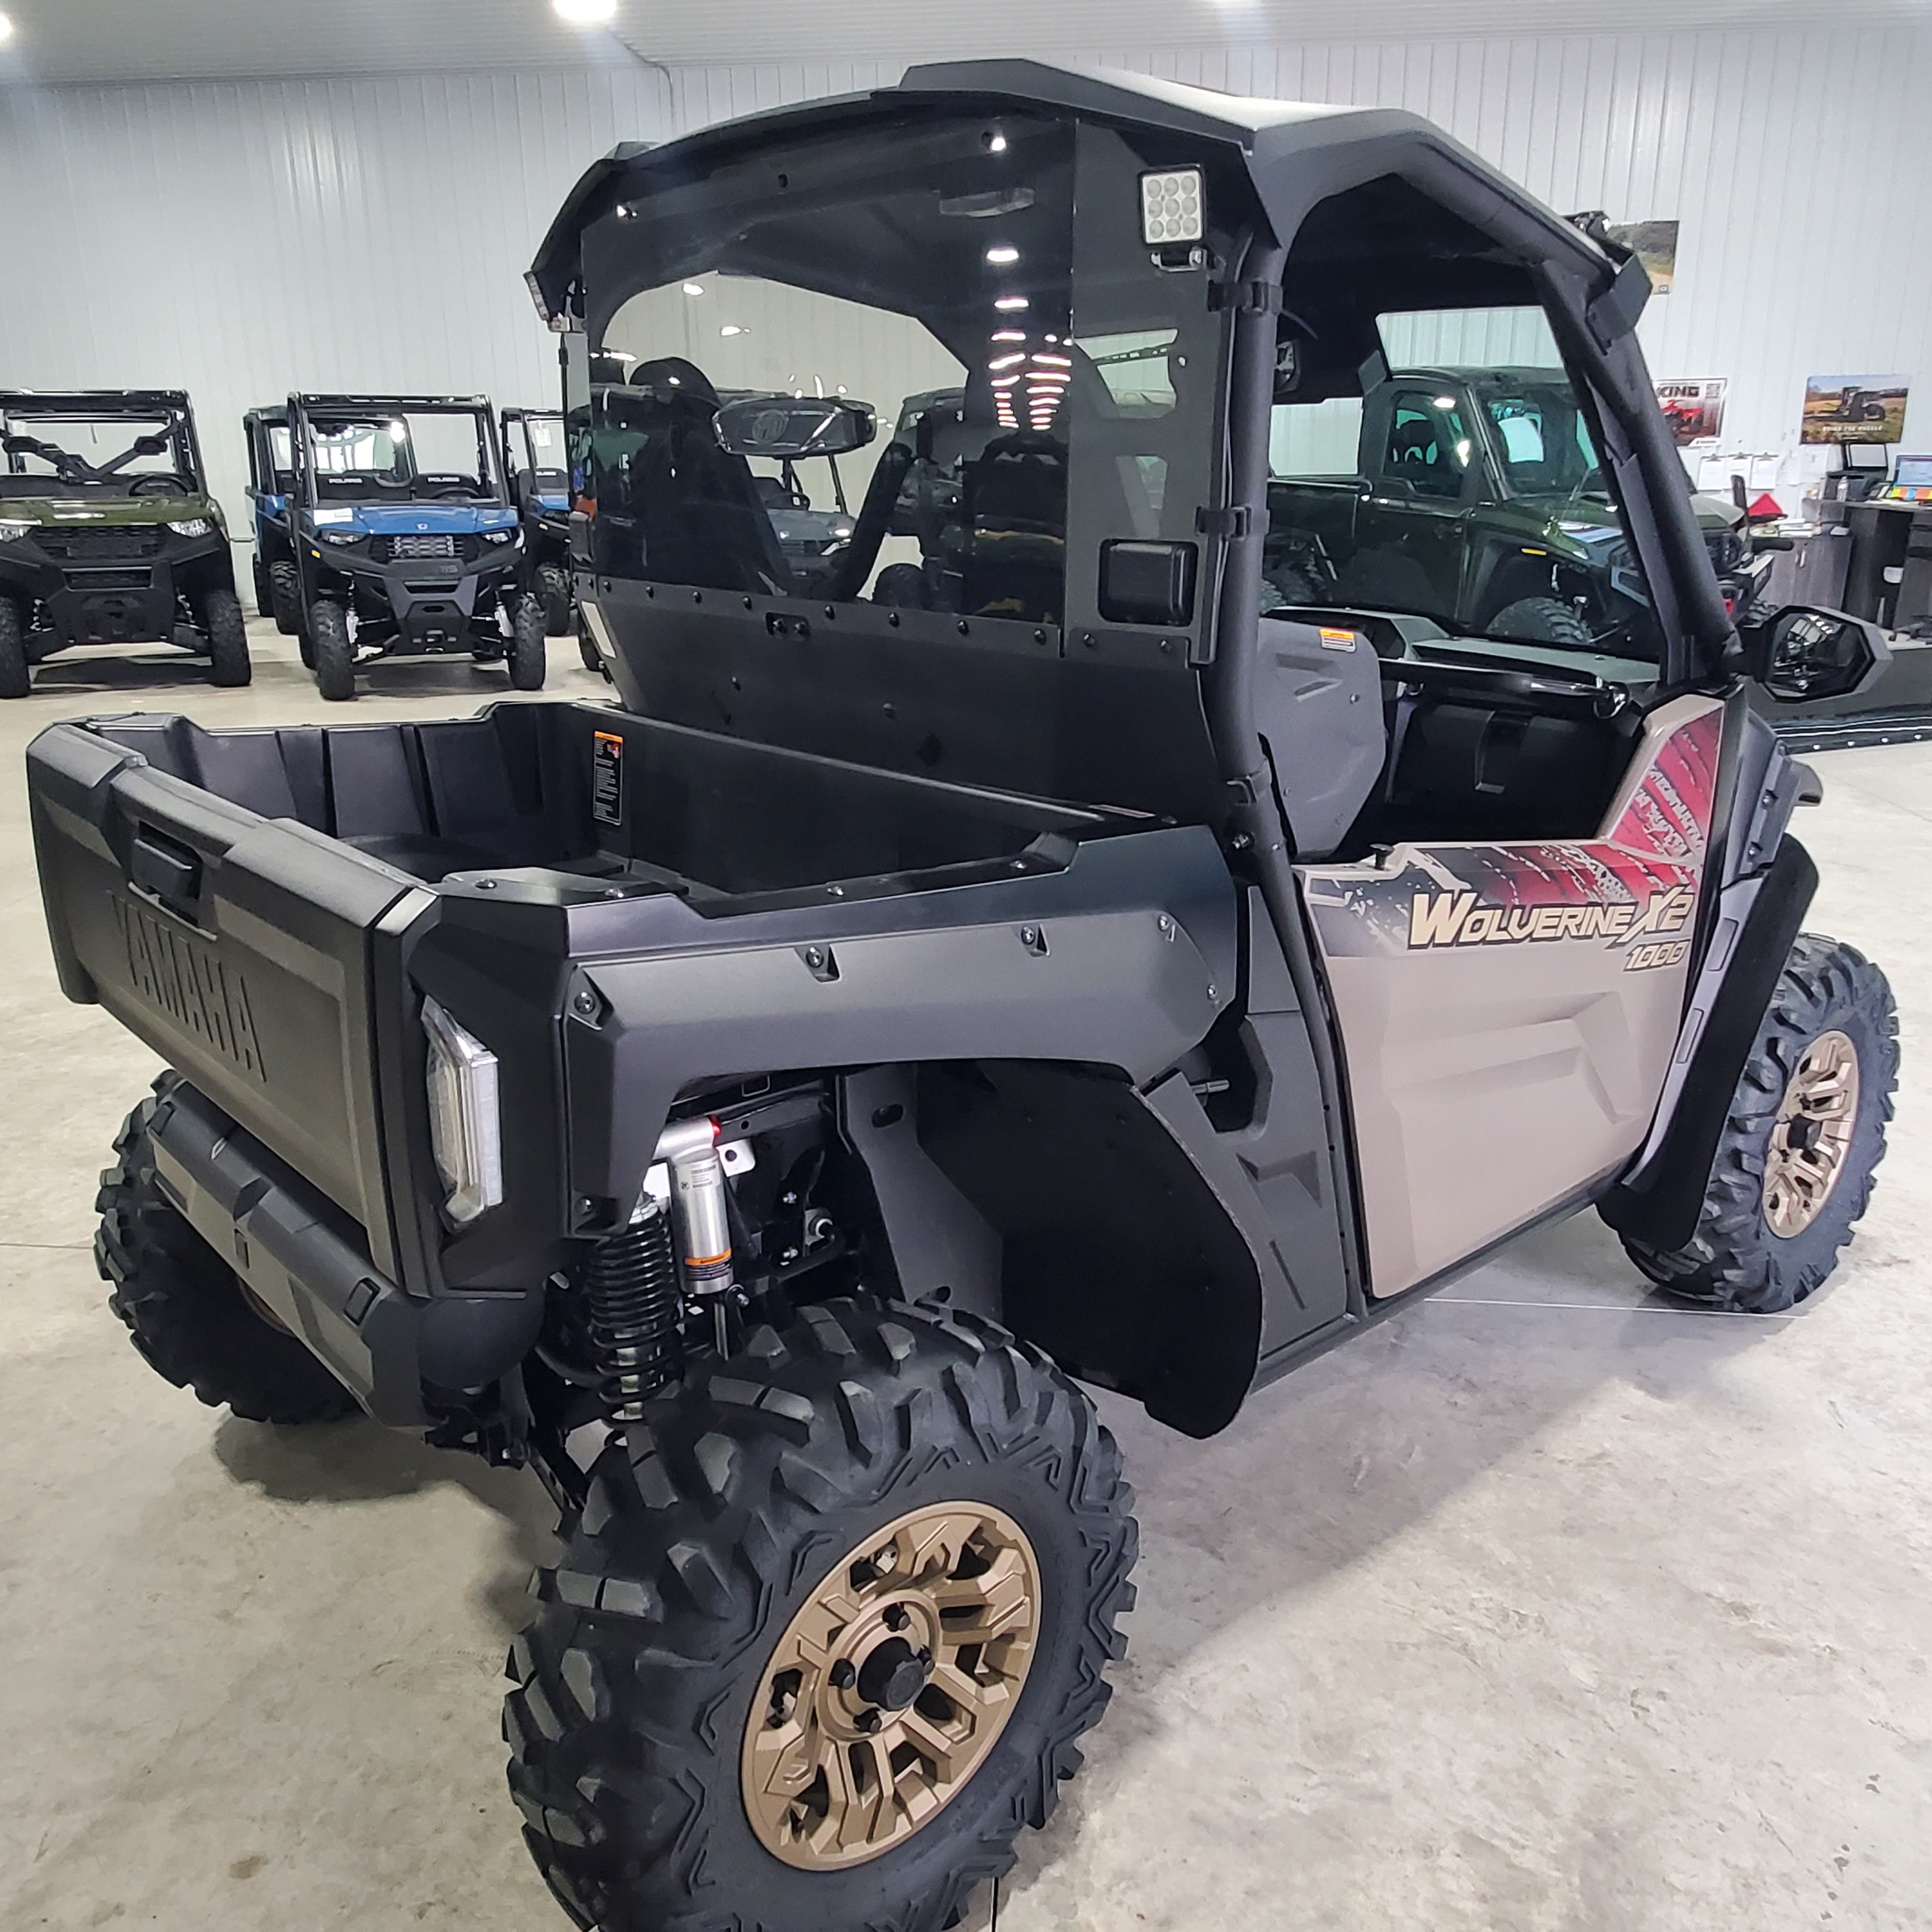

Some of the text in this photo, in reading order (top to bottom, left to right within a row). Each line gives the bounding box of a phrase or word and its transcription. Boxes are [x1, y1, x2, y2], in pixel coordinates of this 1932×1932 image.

[1408, 883, 1695, 950] WOLVERINE X2
[1623, 939, 1691, 971] 1000
